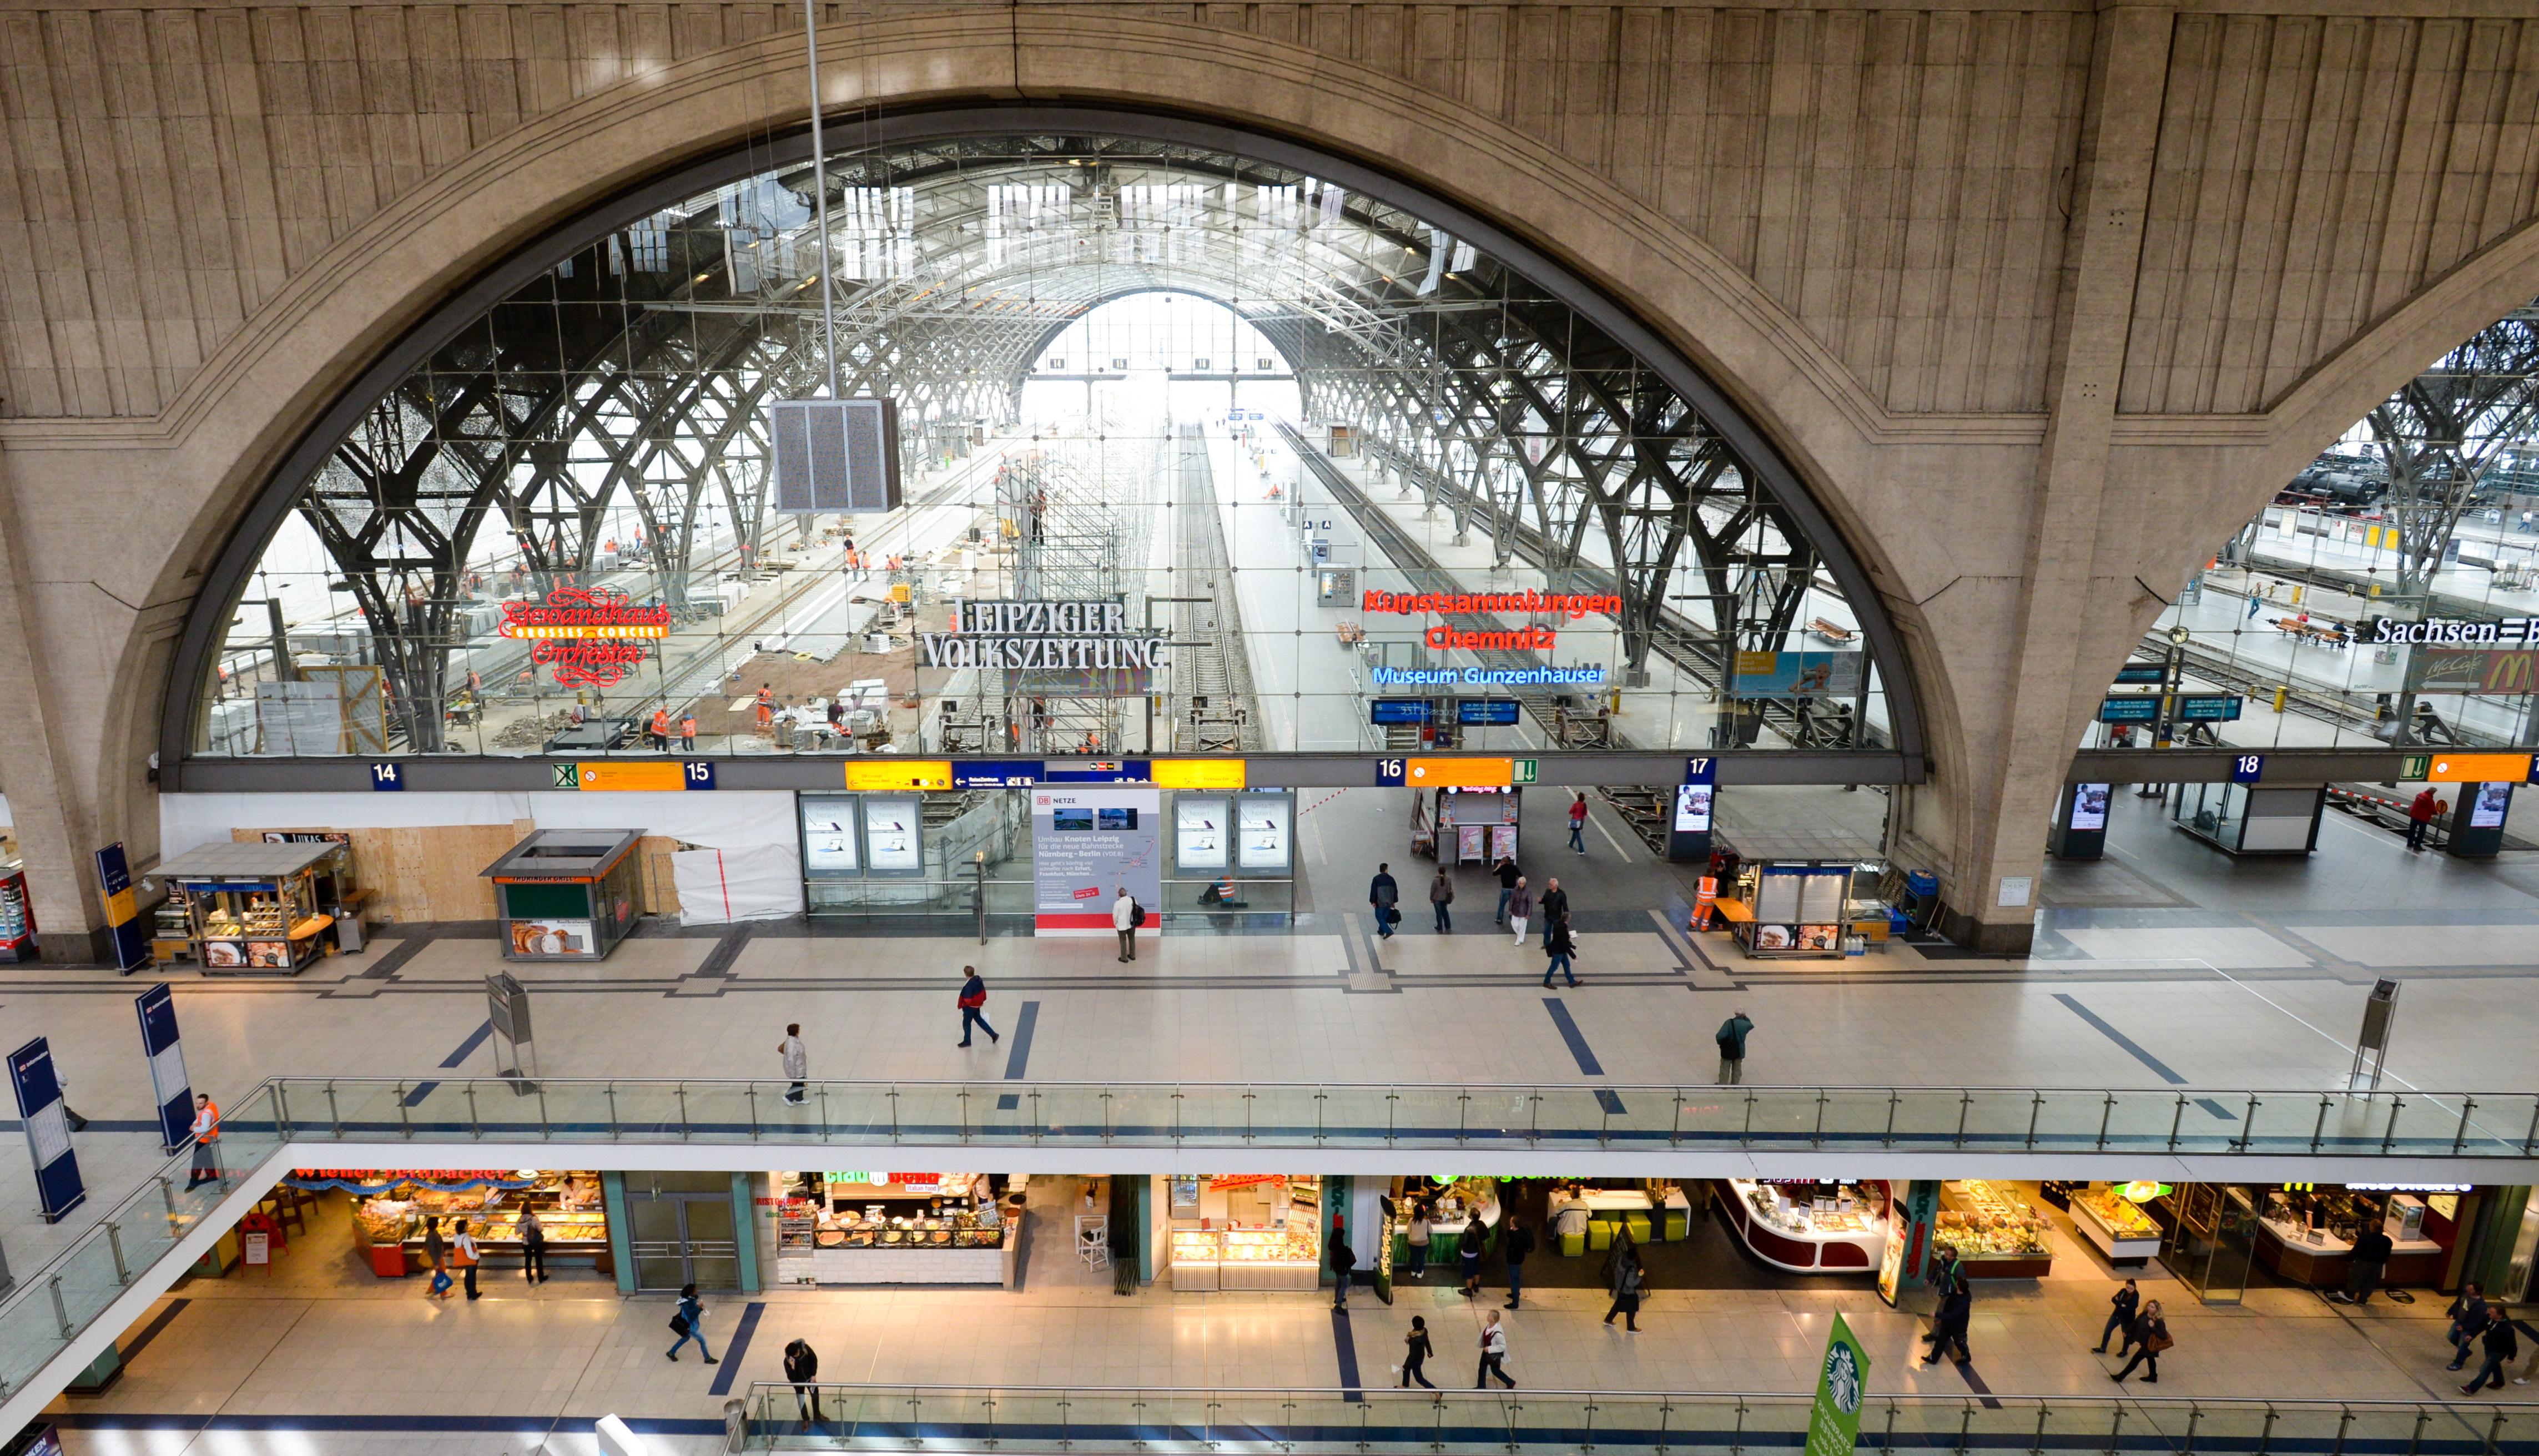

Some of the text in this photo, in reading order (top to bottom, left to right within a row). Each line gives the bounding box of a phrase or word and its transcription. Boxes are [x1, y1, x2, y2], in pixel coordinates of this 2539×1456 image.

[1053, 359, 1062, 368] 14
[1115, 359, 1124, 368] 15
[1198, 359, 1206, 367] 16
[1260, 359, 1270, 368] 17
[1364, 588, 1621, 618] Kunstsammlungen
[498, 592, 671, 634] Gewandhaus
[952, 597, 1124, 633] LEIPZIGER
[516, 627, 663, 638] GROSSES CONCERT
[1425, 625, 1557, 650] Chemnitz
[2374, 618, 2496, 644] Sachsen
[532, 633, 646, 673] Orchester
[921, 632, 1165, 669] VOLKSZEITUNG
[1372, 665, 1606, 684] Museum Gunzenhauser
[374, 764, 396, 781] 14
[687, 763, 709, 780] 15
[1379, 759, 1401, 777] 16
[1690, 758, 1709, 774] 17
[2238, 756, 2259, 773] 18
[755, 1197, 807, 1206] RISTORANTE
